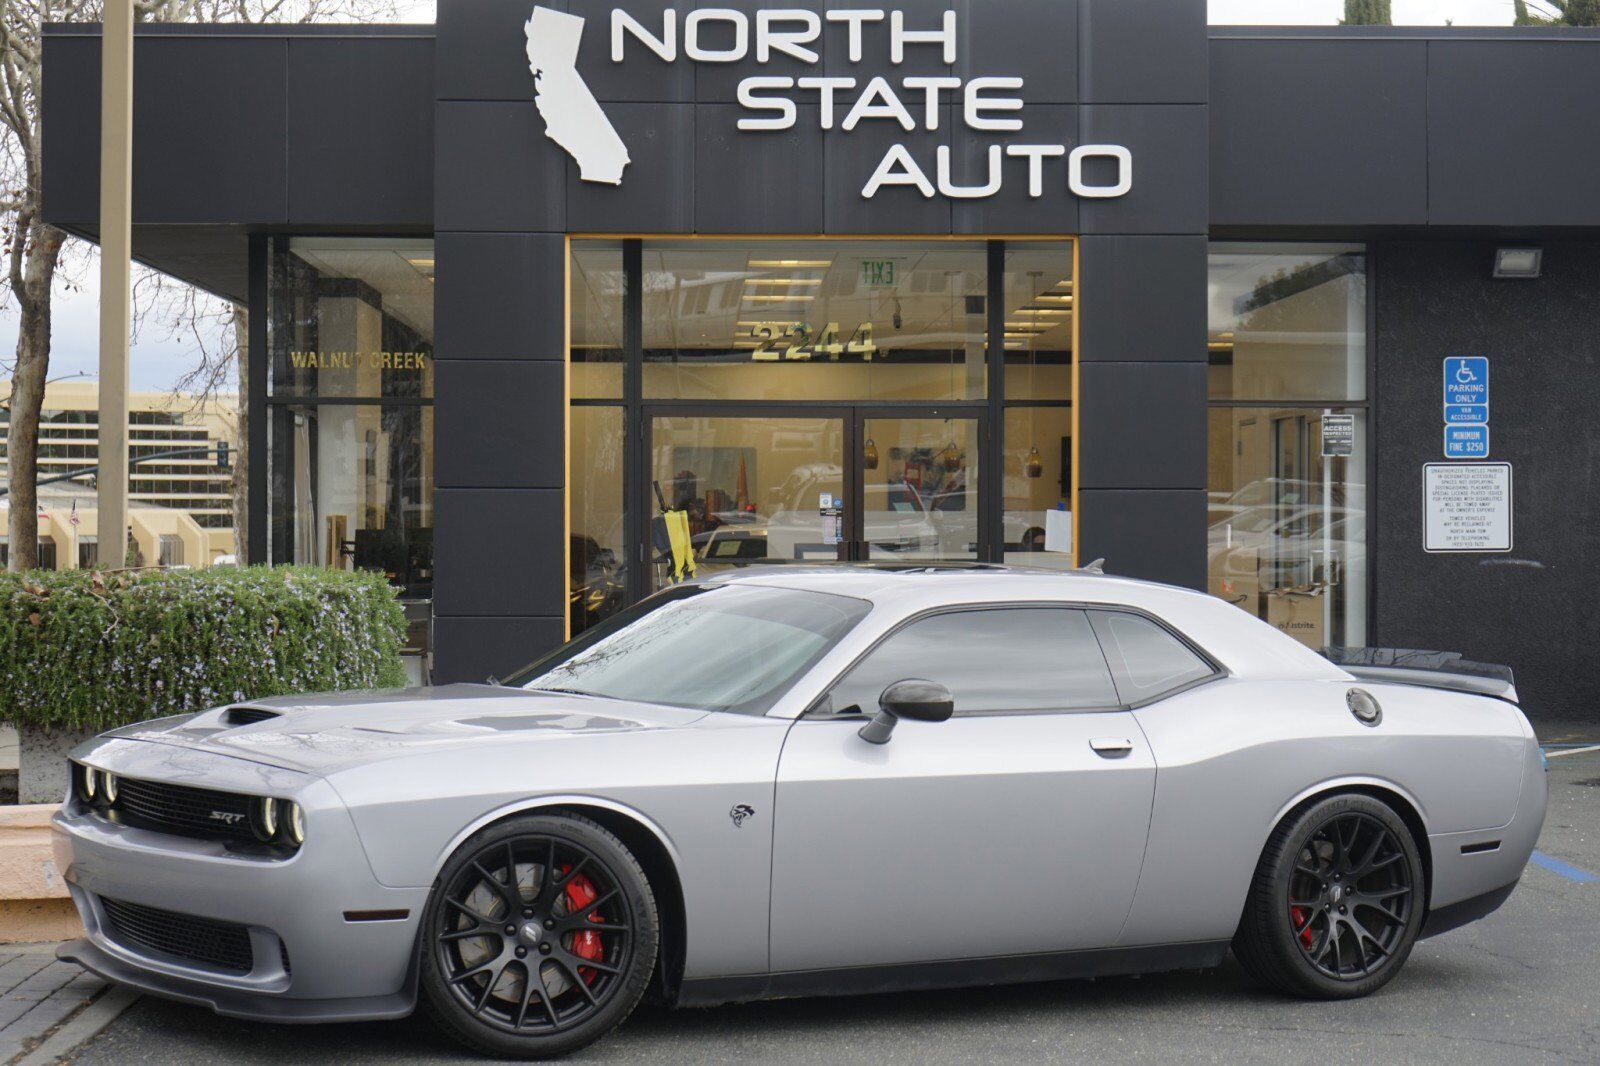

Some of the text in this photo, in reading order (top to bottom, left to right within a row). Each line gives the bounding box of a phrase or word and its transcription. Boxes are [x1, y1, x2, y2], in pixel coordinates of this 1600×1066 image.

[610, 8, 957, 64] NORTH
[736, 76, 1024, 131] STATE
[861, 143, 1133, 198] AUTO
[751, 321, 877, 361] 2244
[291, 351, 426, 369] WALNUT CREEK
[1448, 384, 1484, 392] PARKING
[1455, 394, 1477, 402] ONLY
[1452, 431, 1480, 440] MINIMUM
[1450, 442, 1484, 452] FINE $250
[209, 810, 246, 824] SRT
